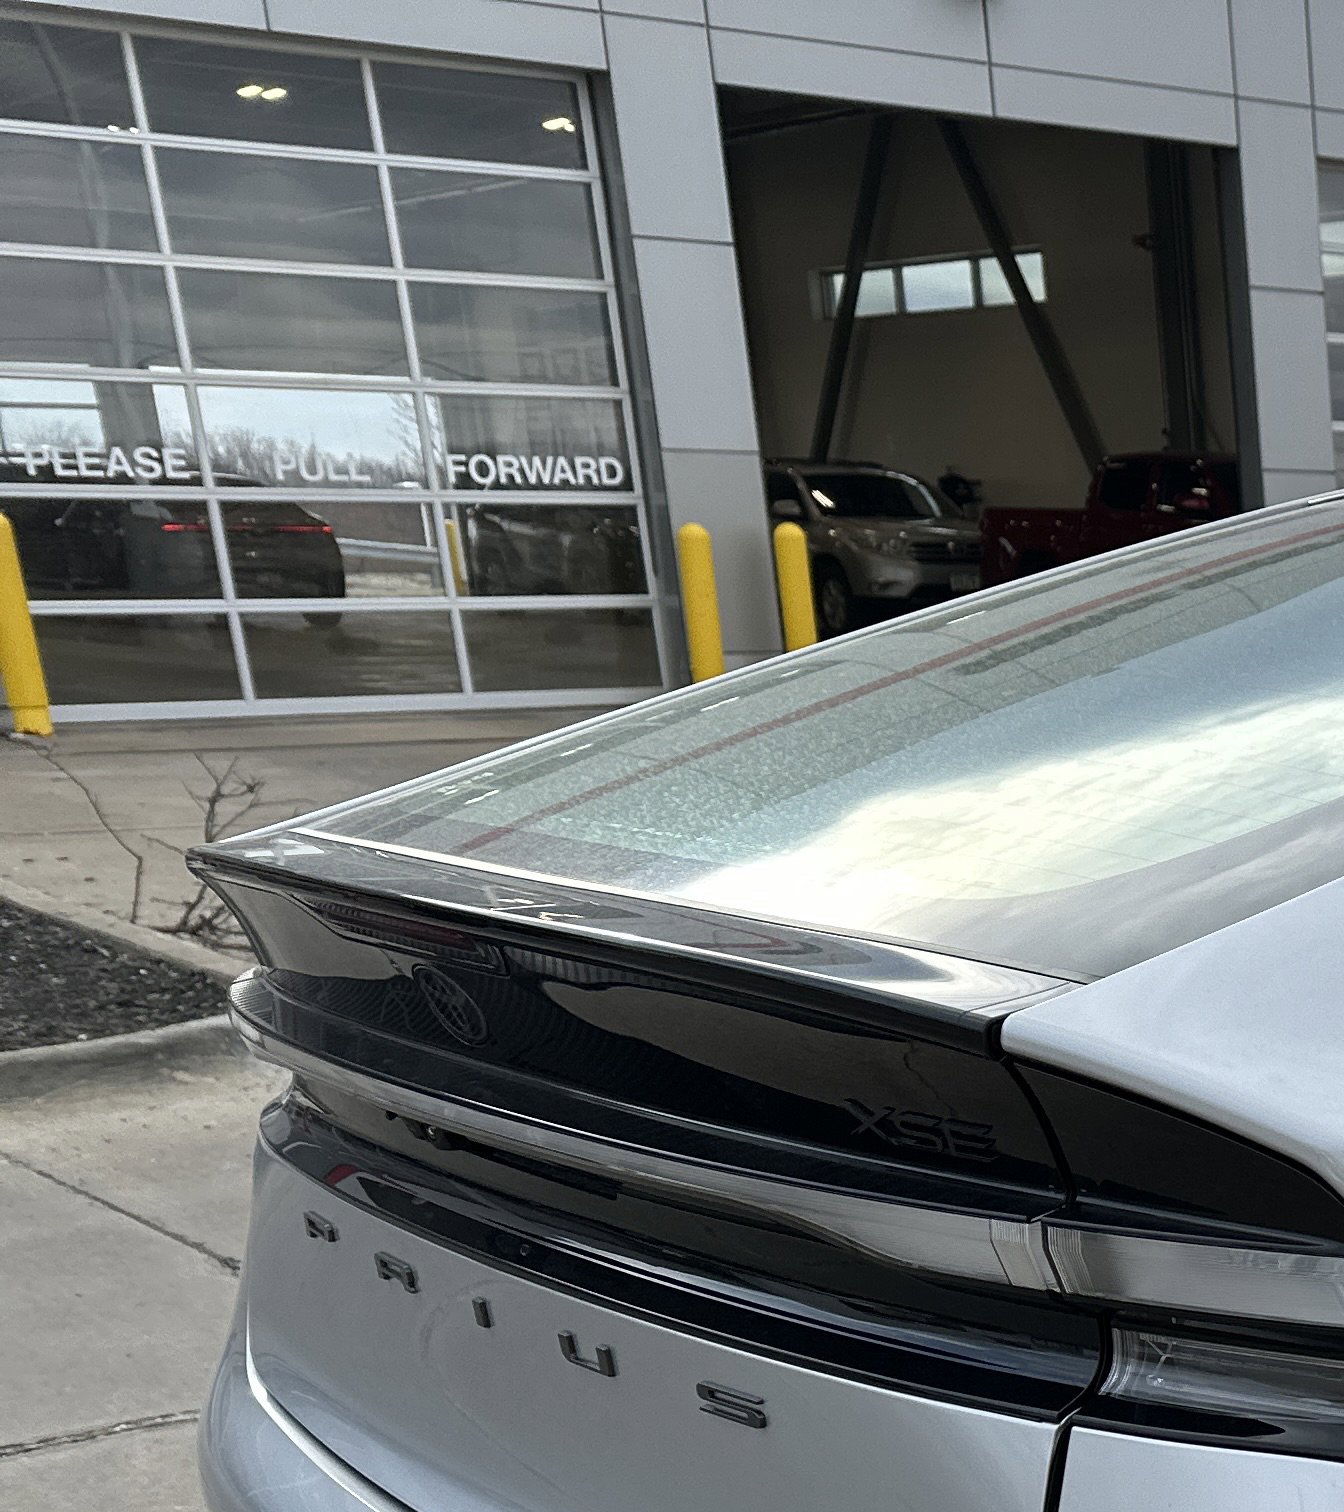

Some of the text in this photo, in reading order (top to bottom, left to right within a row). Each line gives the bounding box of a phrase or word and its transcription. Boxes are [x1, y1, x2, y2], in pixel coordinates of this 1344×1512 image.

[26, 446, 624, 487] PLEASE PULL FORWARD
[846, 1098, 998, 1160] XSE
[304, 1211, 767, 1429] PRIUS
